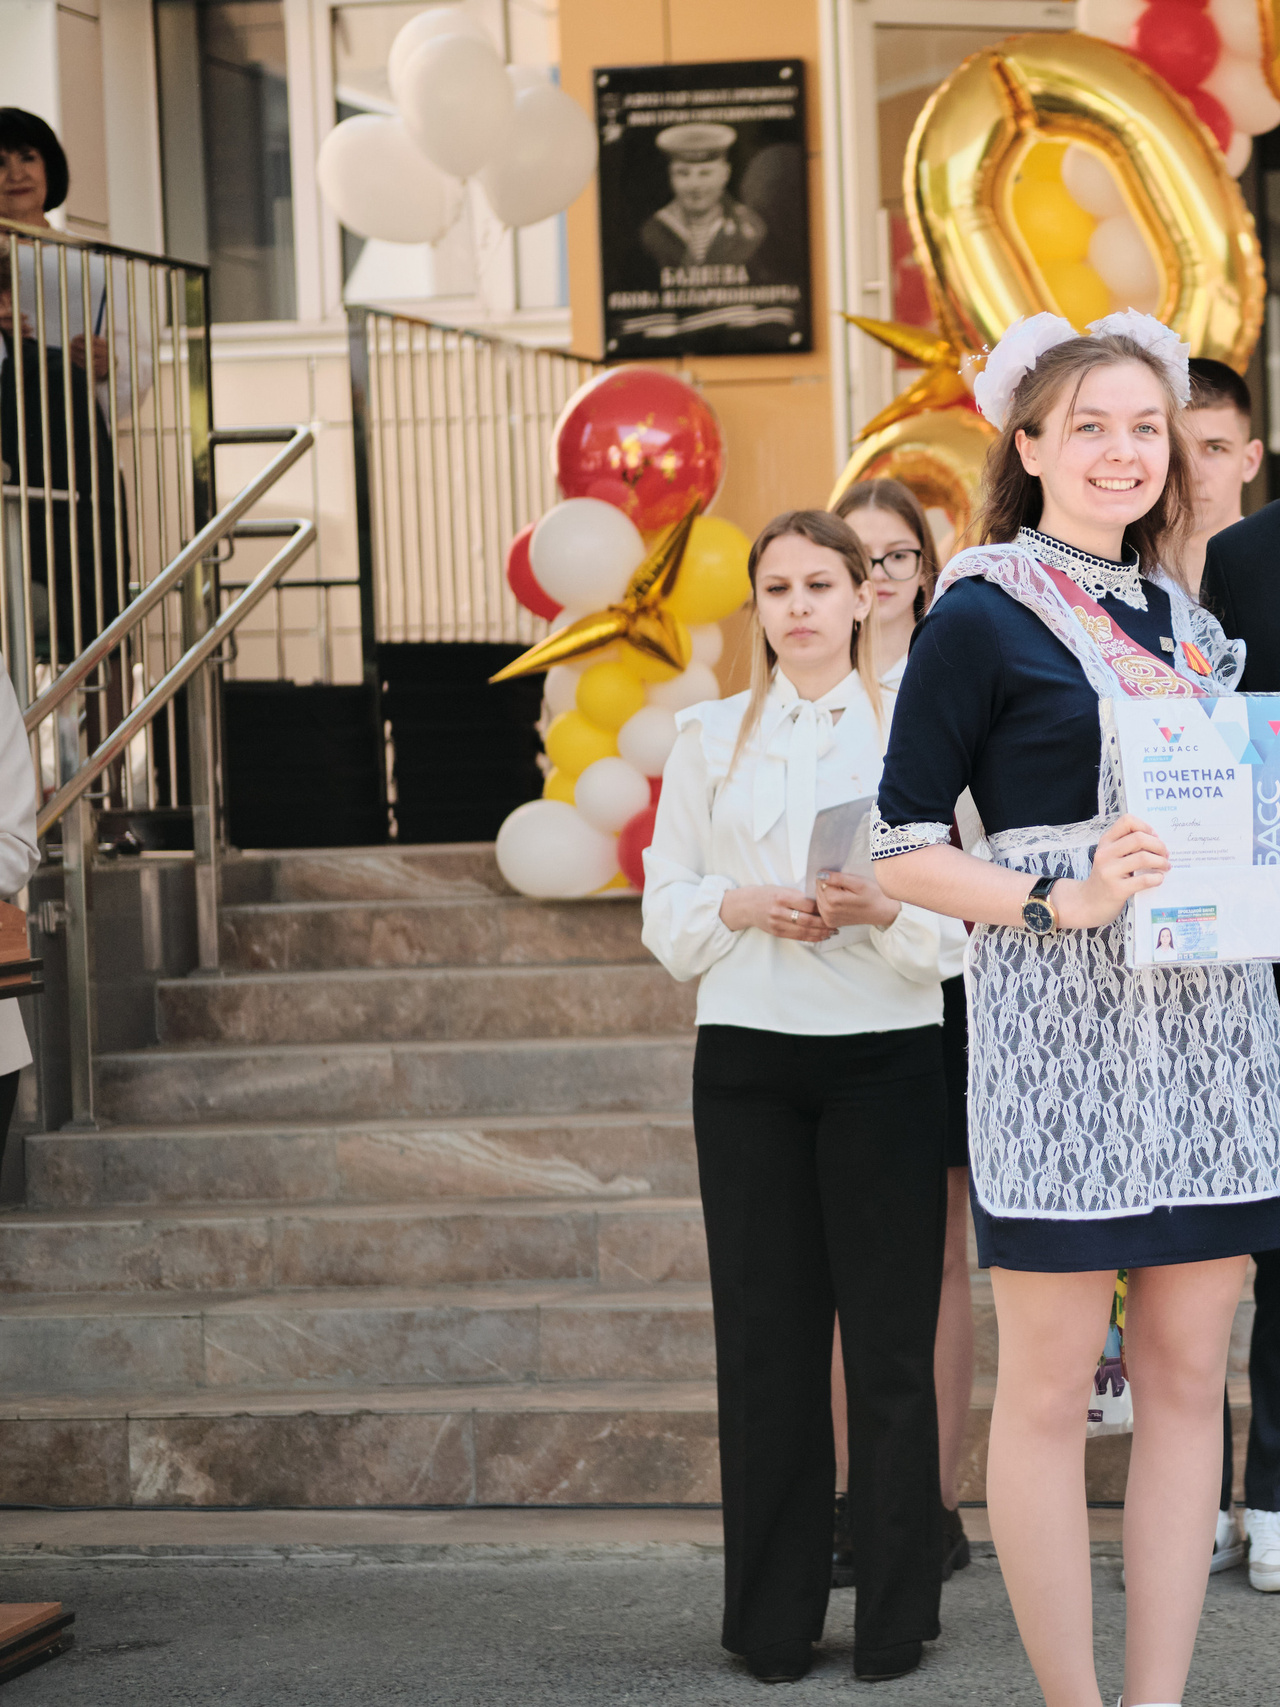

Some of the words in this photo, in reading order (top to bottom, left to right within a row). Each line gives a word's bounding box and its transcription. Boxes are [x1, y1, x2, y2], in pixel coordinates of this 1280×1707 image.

[1144, 745, 1199, 753] КУЗБАСС
[1143, 768, 1235, 783] ПОЧЕТНАЯ
[1145, 786, 1224, 800] ГРАМОТА
